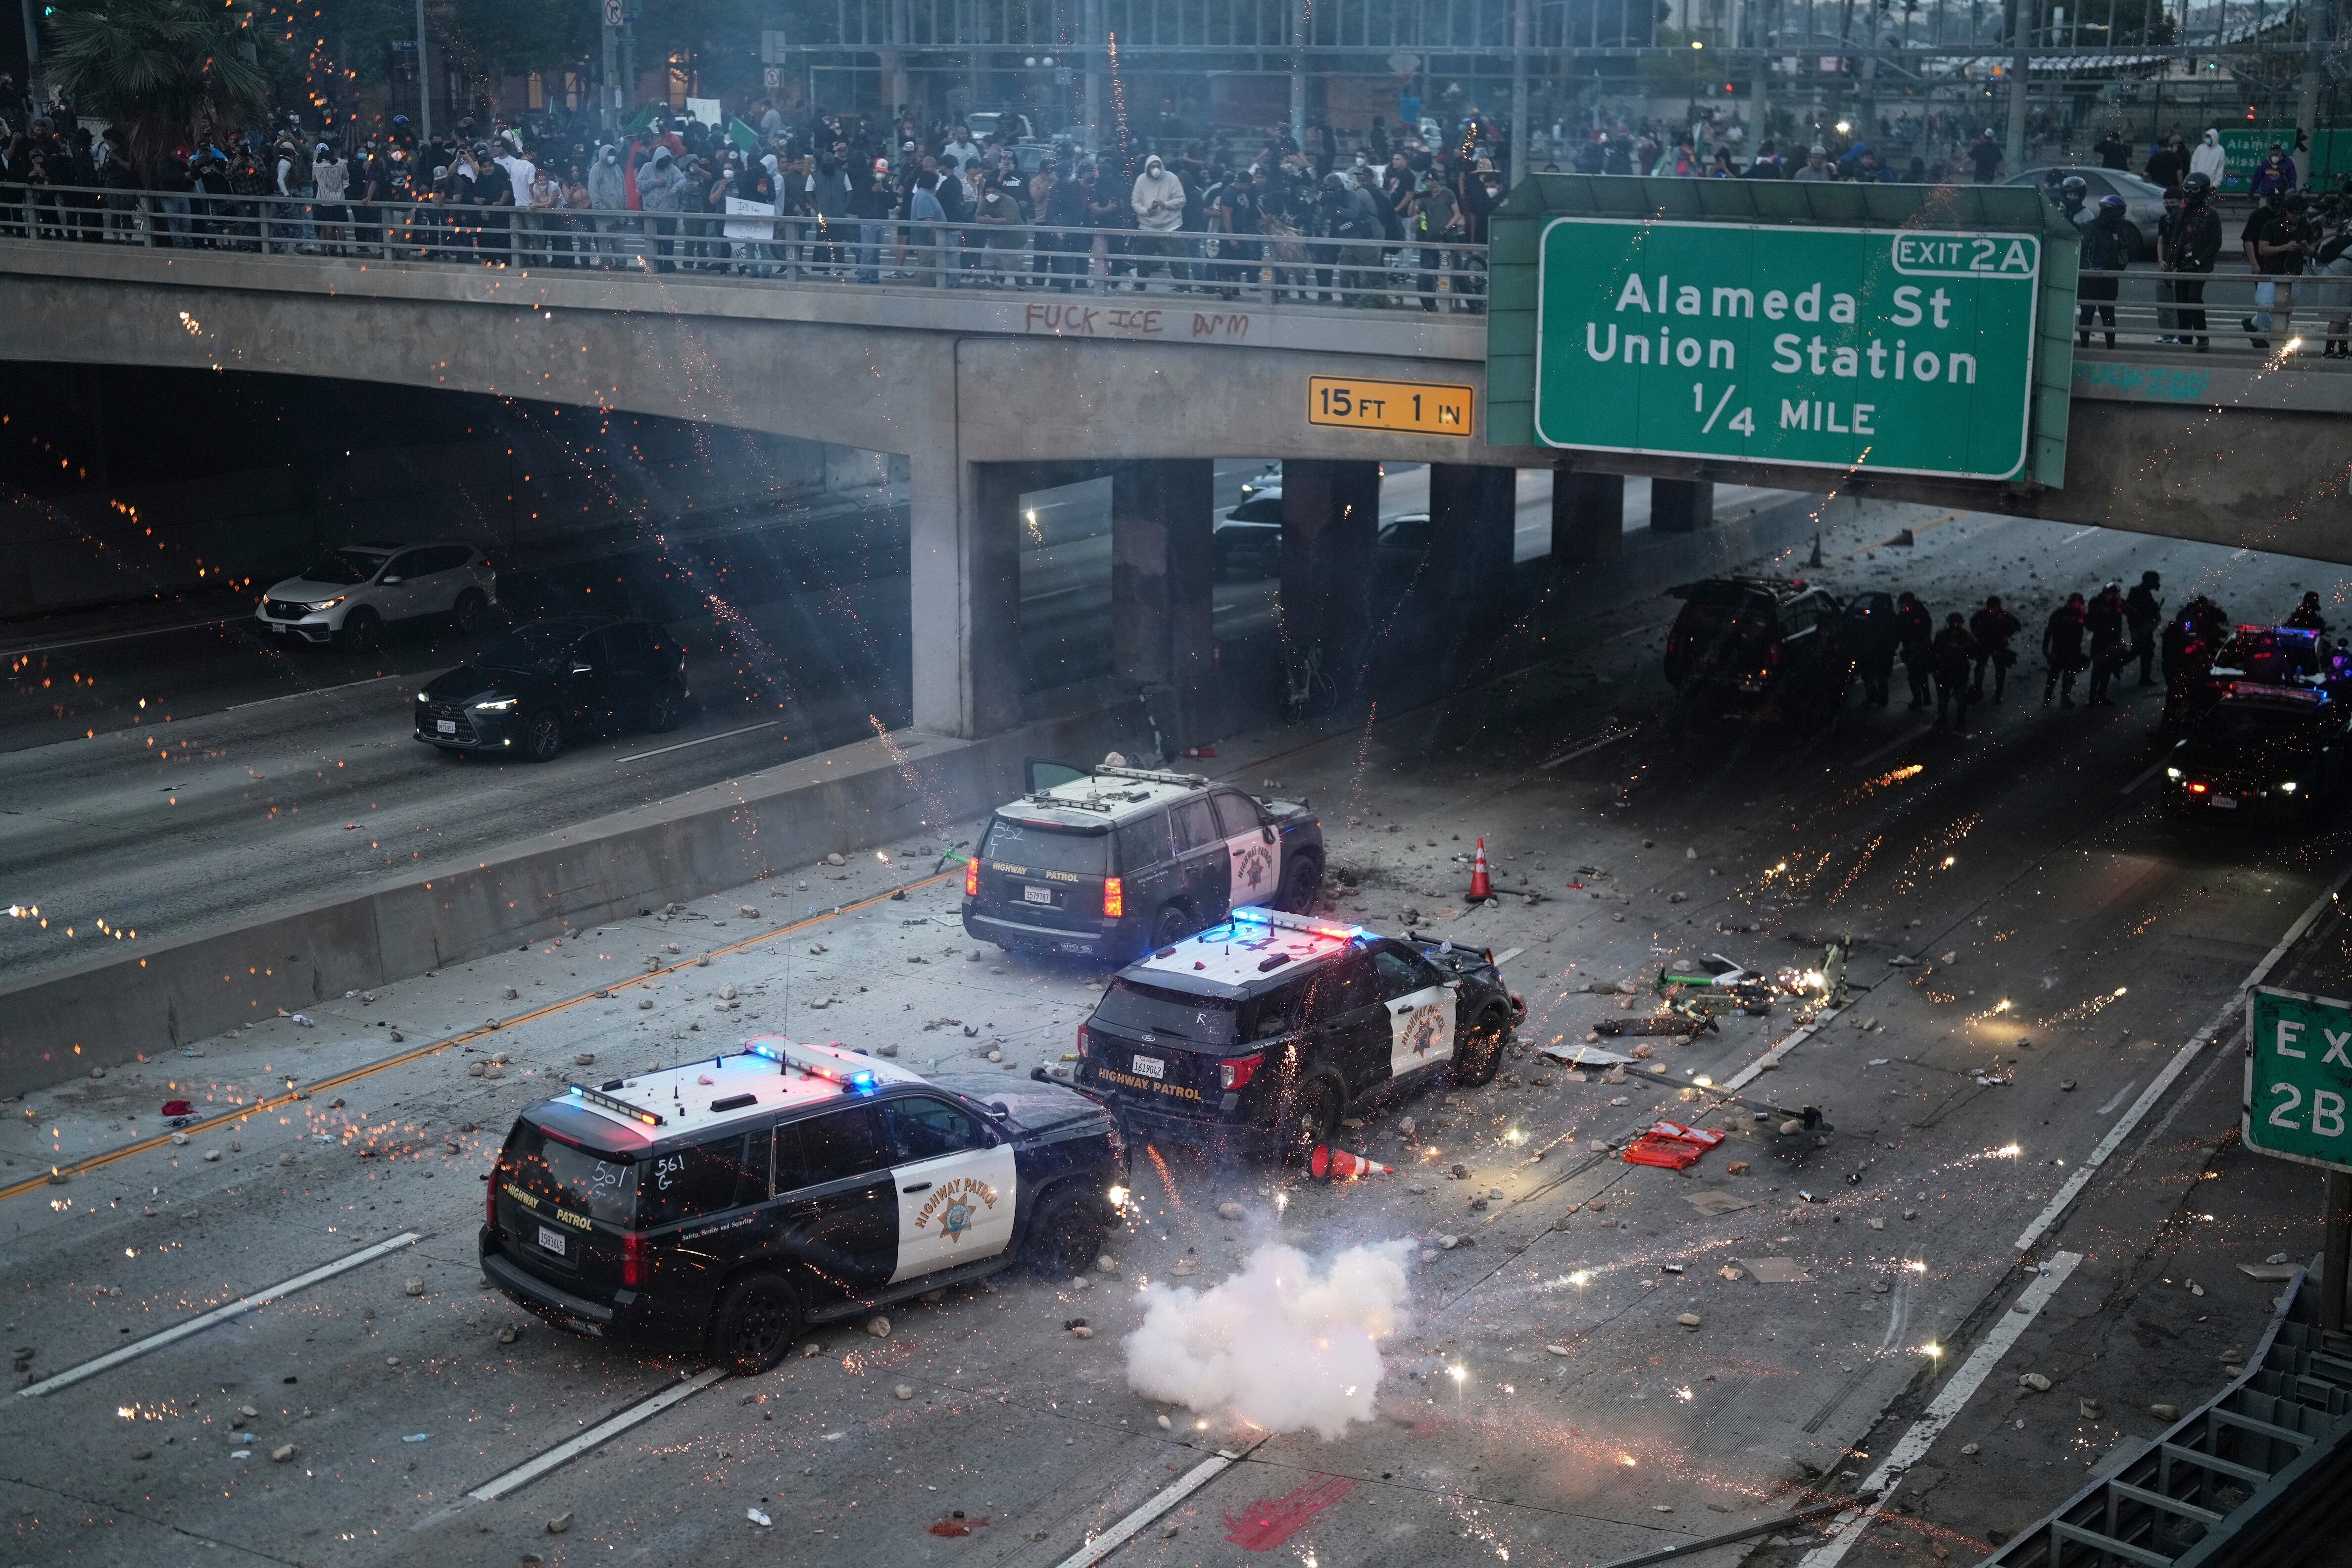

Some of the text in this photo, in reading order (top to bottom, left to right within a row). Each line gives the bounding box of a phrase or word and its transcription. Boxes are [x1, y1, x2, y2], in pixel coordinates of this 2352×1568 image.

[2227, 139, 2289, 149] Alamda
[1900, 239, 2030, 272] EXIT 2A
[1616, 273, 1951, 328] Alameda St
[1026, 304, 1100, 335] FUCK
[1109, 310, 1164, 334] ICE
[1587, 322, 1976, 384] Union Station
[1321, 388, 1460, 425] 15 FT 1 IN
[1693, 383, 1875, 437] 1/4 MILE
[994, 822, 1025, 840] 552
[993, 862, 1079, 882] HIGHWAY PATROL
[1238, 845, 1257, 879] HIGHWAY
[1027, 891, 1049, 901] 1579787
[1196, 1013, 1207, 1024] R
[1401, 1005, 1427, 1045] HIGHWAY
[1427, 1004, 1445, 1033] PATROL
[1098, 1068, 1202, 1100] HIGHWAY PATROL
[1134, 1062, 1162, 1076] 1619042
[2268, 1082, 2346, 1137] 2B
[592, 1160, 627, 1187] 561
[655, 1155, 685, 1176] 561
[659, 1175, 673, 1190] G
[507, 1183, 592, 1231] HIGHWAY PATROL
[914, 1177, 998, 1229] HIGHWAY PATROL
[540, 1232, 563, 1251] 1583645
[682, 1232, 700, 1241] Safety,
[701, 1226, 719, 1236] Service
[732, 1218, 752, 1227] Security
